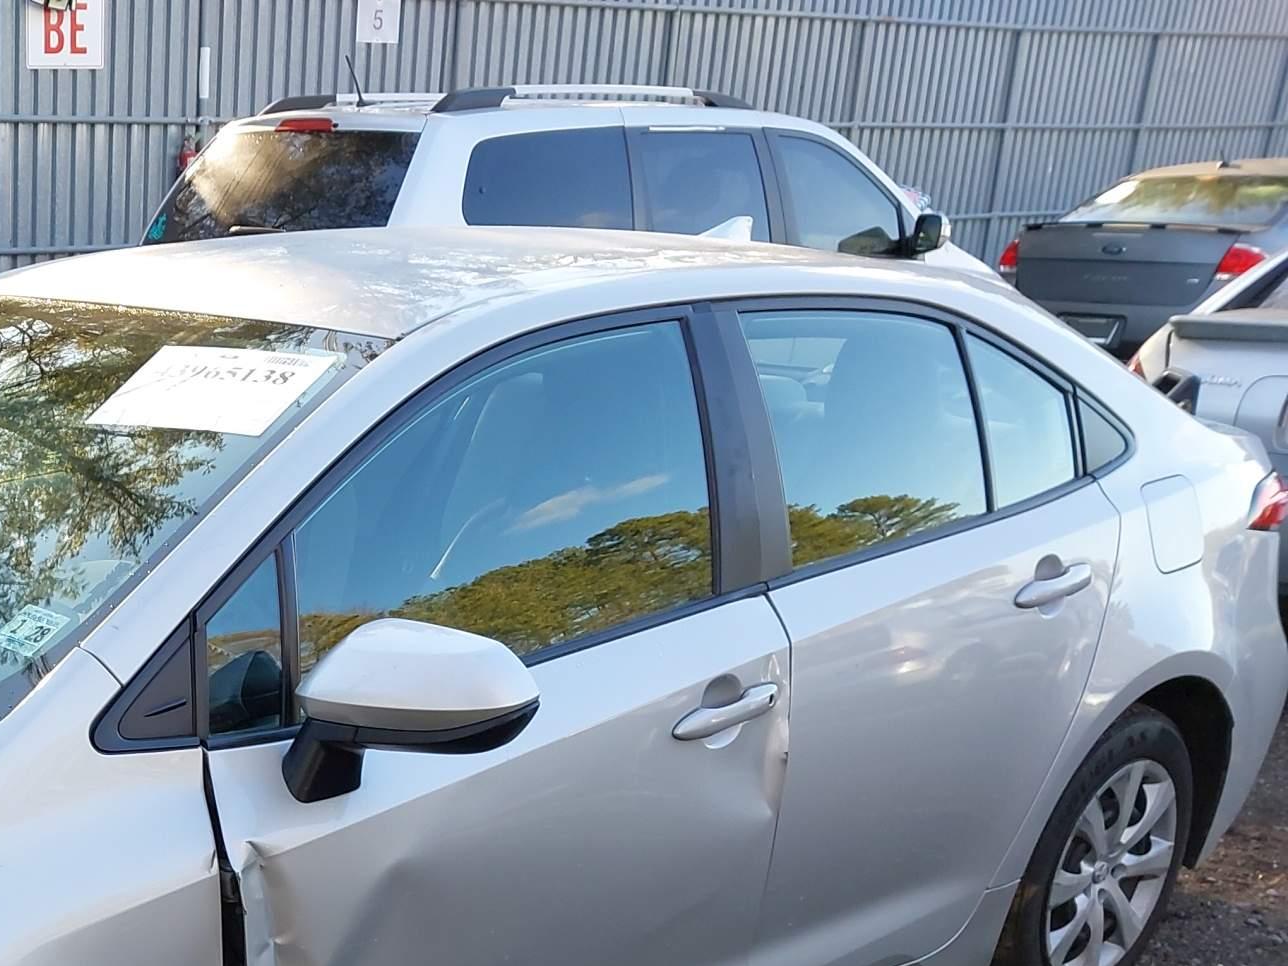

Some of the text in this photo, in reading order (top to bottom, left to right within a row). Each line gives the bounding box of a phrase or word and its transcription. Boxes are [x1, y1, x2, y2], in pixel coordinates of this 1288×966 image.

[43, 2, 88, 54] BE
[373, 9, 384, 30] 5
[10, 619, 27, 635] 1
[24, 626, 52, 643] 28
